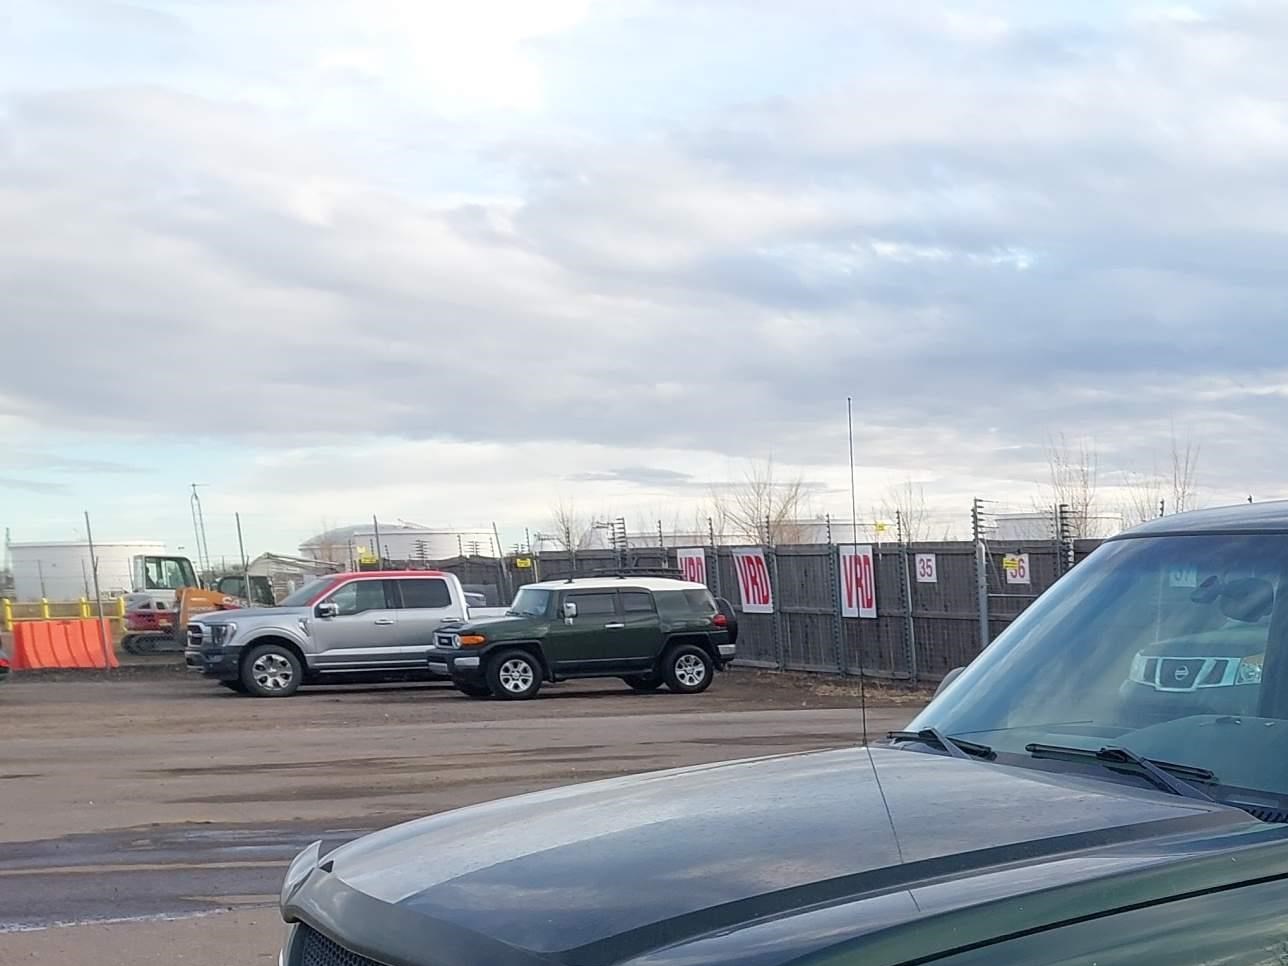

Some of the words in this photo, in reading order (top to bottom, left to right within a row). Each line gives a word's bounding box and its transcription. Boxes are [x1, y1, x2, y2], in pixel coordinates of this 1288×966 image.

[734, 555, 770, 605] VRD
[842, 554, 874, 609] VRD
[918, 558, 933, 578] 35
